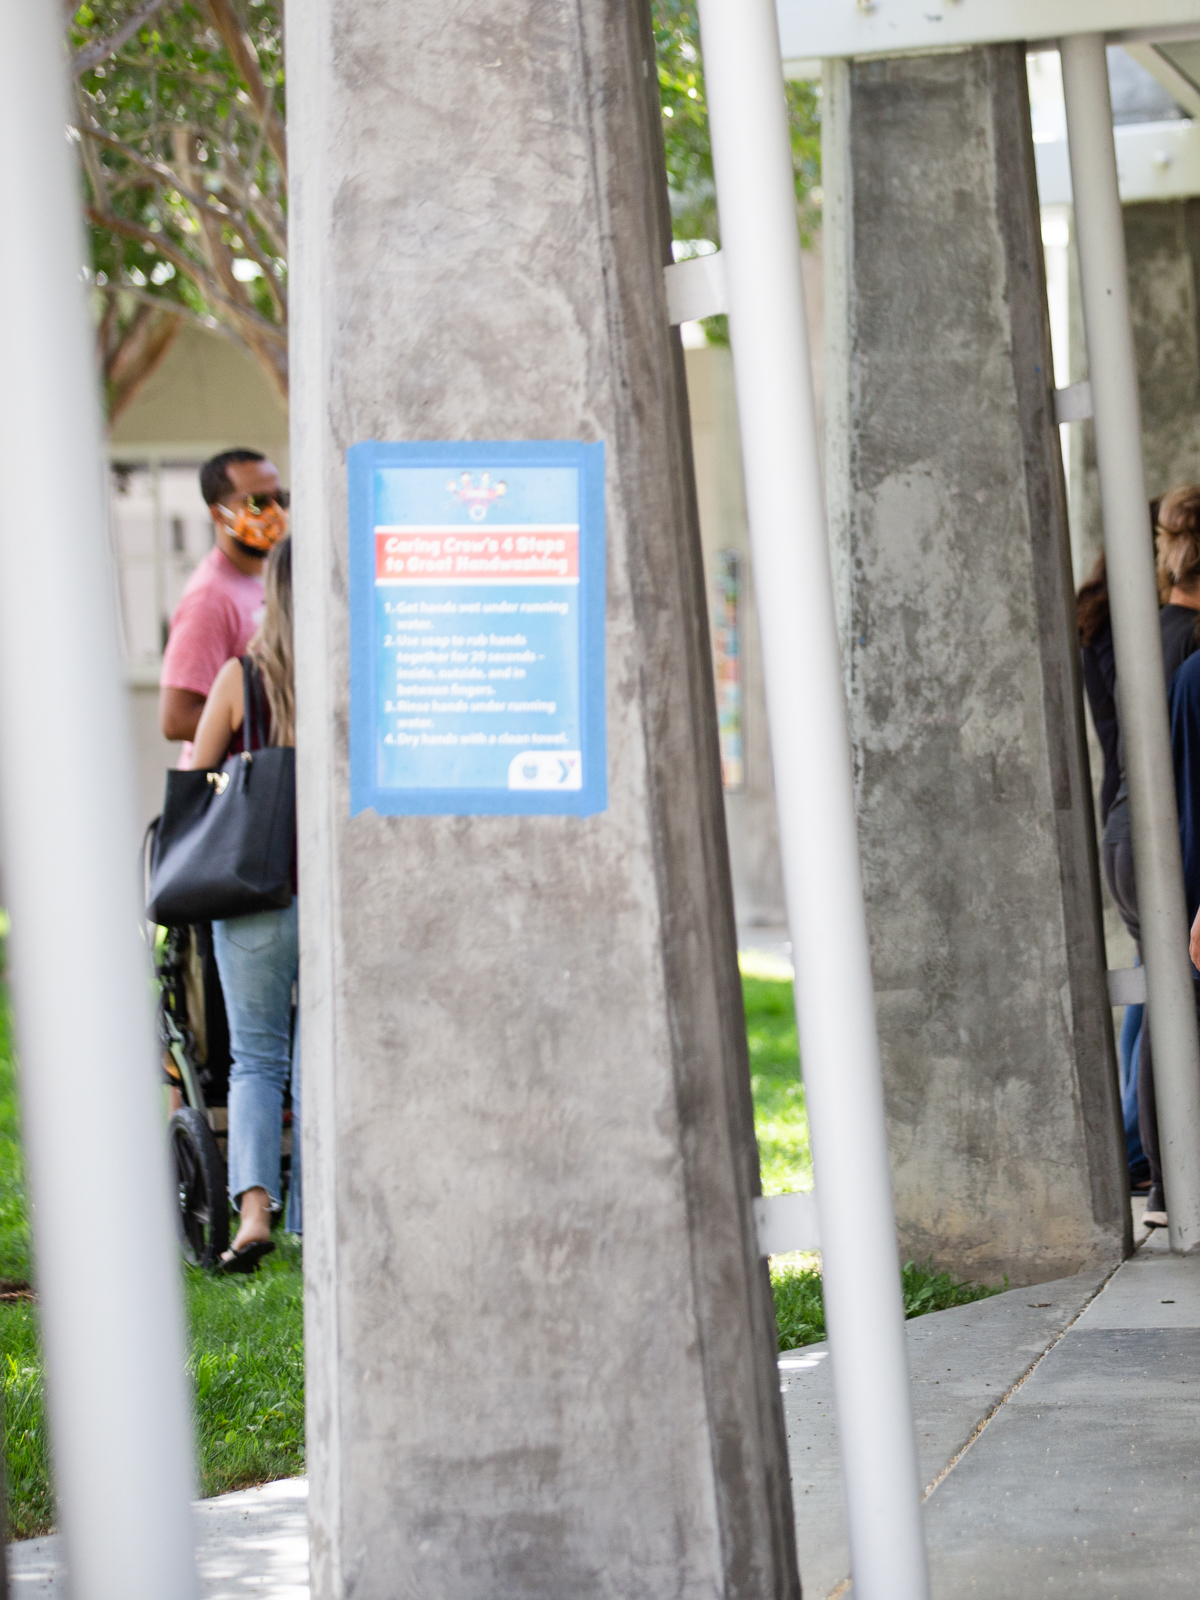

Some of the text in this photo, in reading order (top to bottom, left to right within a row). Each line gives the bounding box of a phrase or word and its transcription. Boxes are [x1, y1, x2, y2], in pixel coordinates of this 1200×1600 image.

[385, 536, 566, 556] Caring Crew's 4 Steps
[385, 555, 568, 575] to Great Handwashing
[384, 600, 568, 615] 1. Get hands wet under running
[396, 619, 434, 630] water.
[384, 633, 527, 649] 2. Use soap to rub hands
[396, 651, 449, 665] together
[450, 650, 469, 663] for
[470, 651, 487, 663] 20
[487, 650, 536, 663] seconds
[396, 666, 526, 680] inside, outside, and in
[396, 682, 496, 698] between fingers.
[397, 700, 430, 713] Rinse
[431, 699, 469, 713] hands
[469, 699, 506, 713] under
[506, 699, 557, 715] running
[397, 717, 435, 729] water.
[384, 732, 569, 747] 4. Dry hands with a clean towel.
